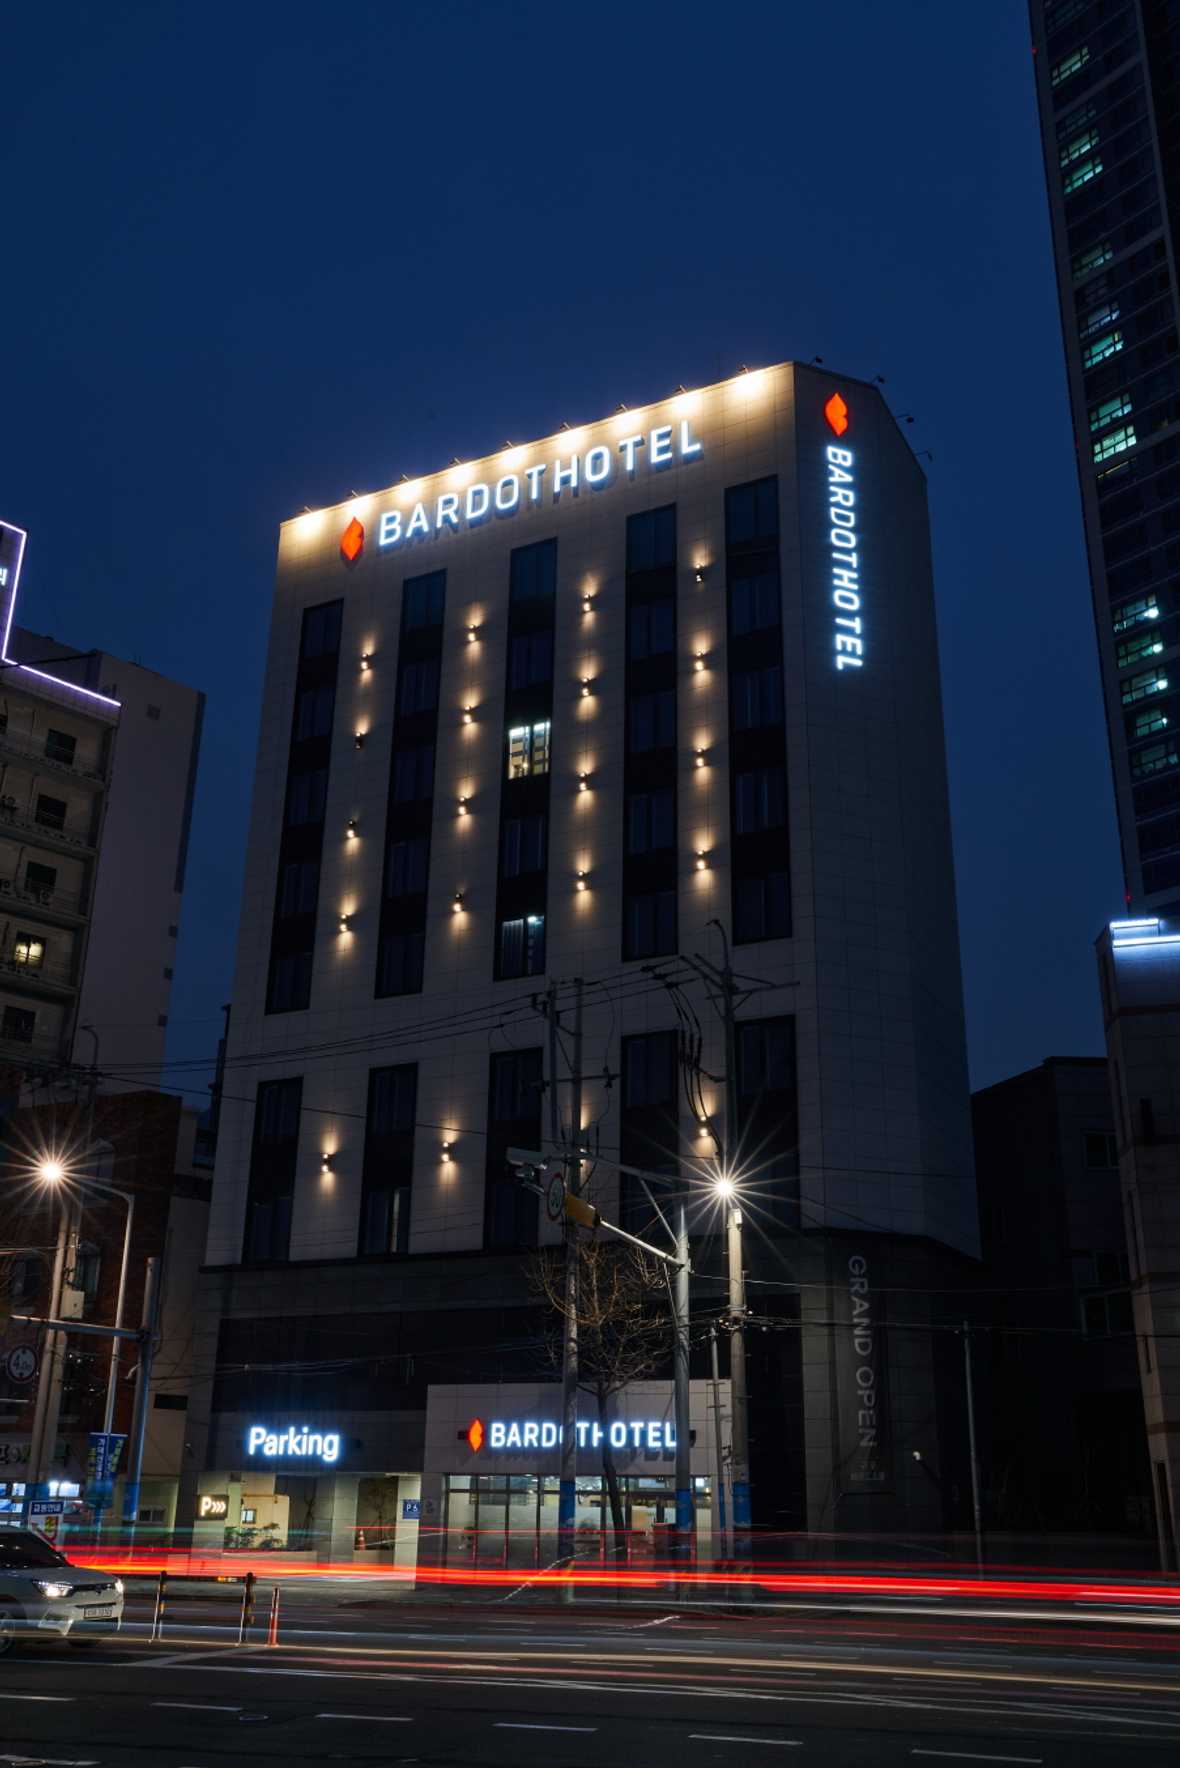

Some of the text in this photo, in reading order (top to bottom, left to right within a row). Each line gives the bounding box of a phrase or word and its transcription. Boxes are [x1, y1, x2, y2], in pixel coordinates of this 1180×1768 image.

[379, 420, 702, 547] BARDOTHOTEL
[825, 445, 863, 671] BARDOTHOTEL
[848, 1255, 873, 1356] GRAND
[248, 1426, 340, 1462] Parking
[490, 1422, 678, 1448] BARDTHOTEL
[856, 1366, 878, 1447] OPEN
